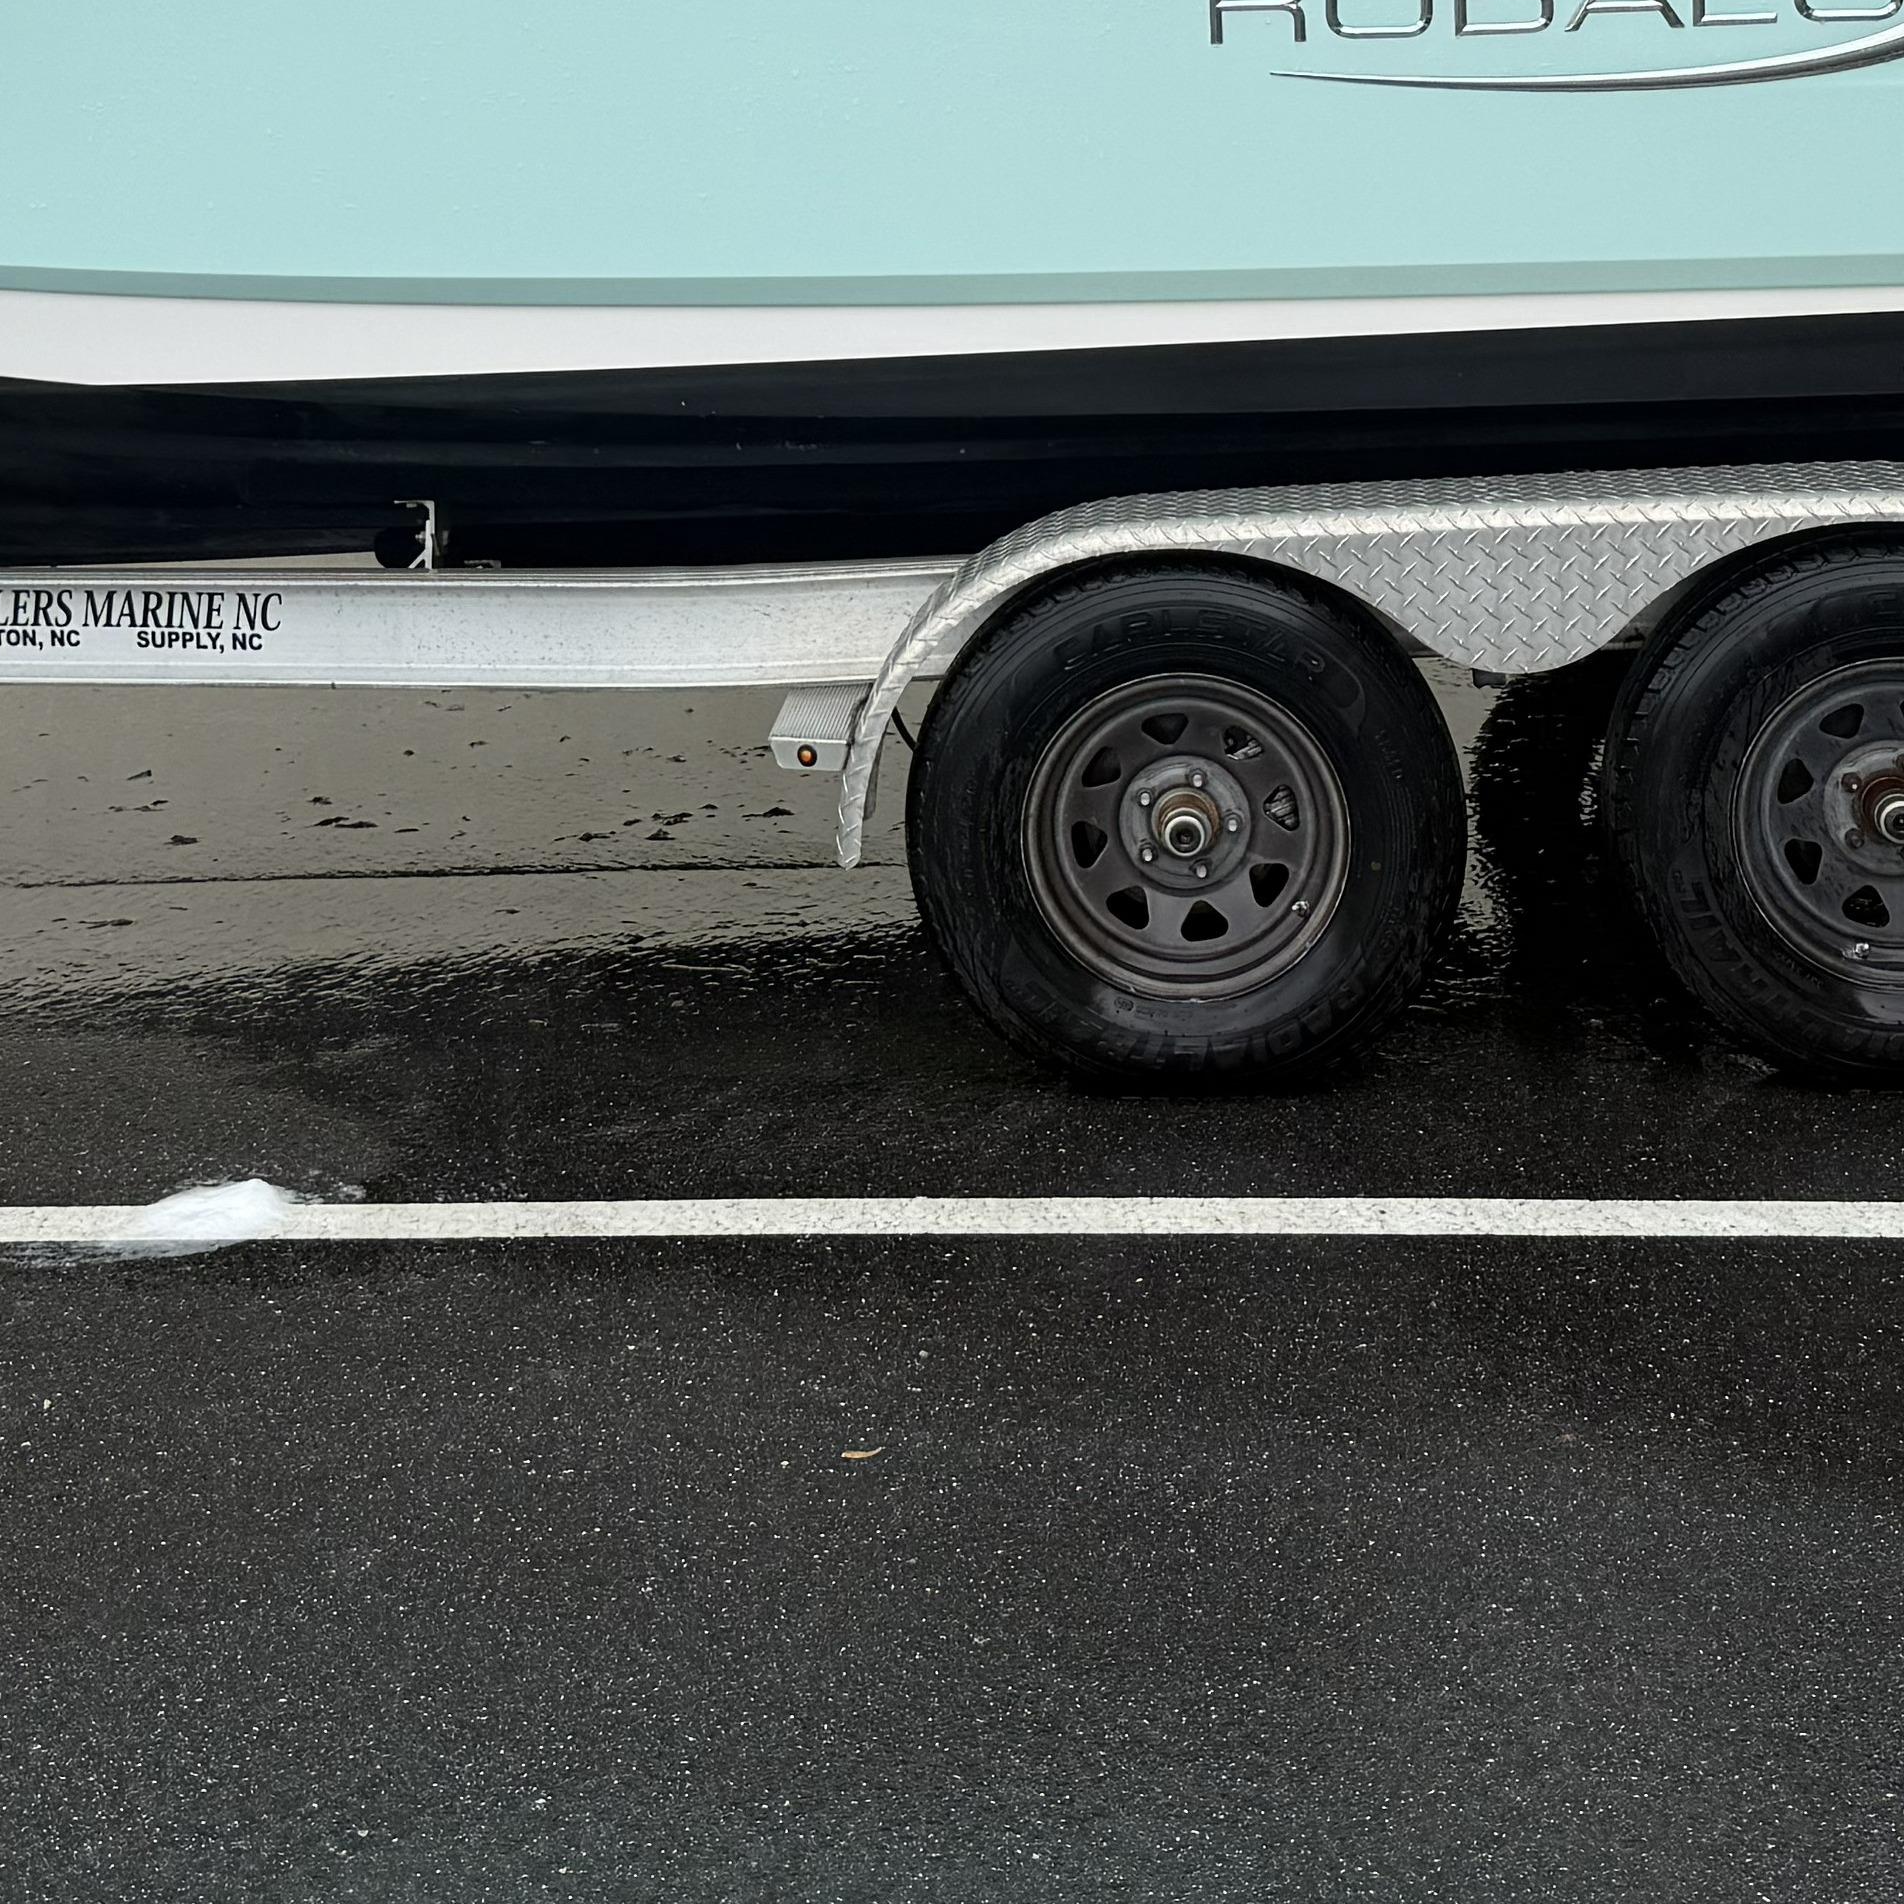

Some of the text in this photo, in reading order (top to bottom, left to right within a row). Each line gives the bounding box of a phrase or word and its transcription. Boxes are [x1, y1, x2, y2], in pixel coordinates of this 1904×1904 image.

[82, 589, 226, 630] MARINE
[233, 592, 283, 632] NC
[51, 630, 81, 647] NC
[137, 630, 263, 654] SUPPLY, NC
